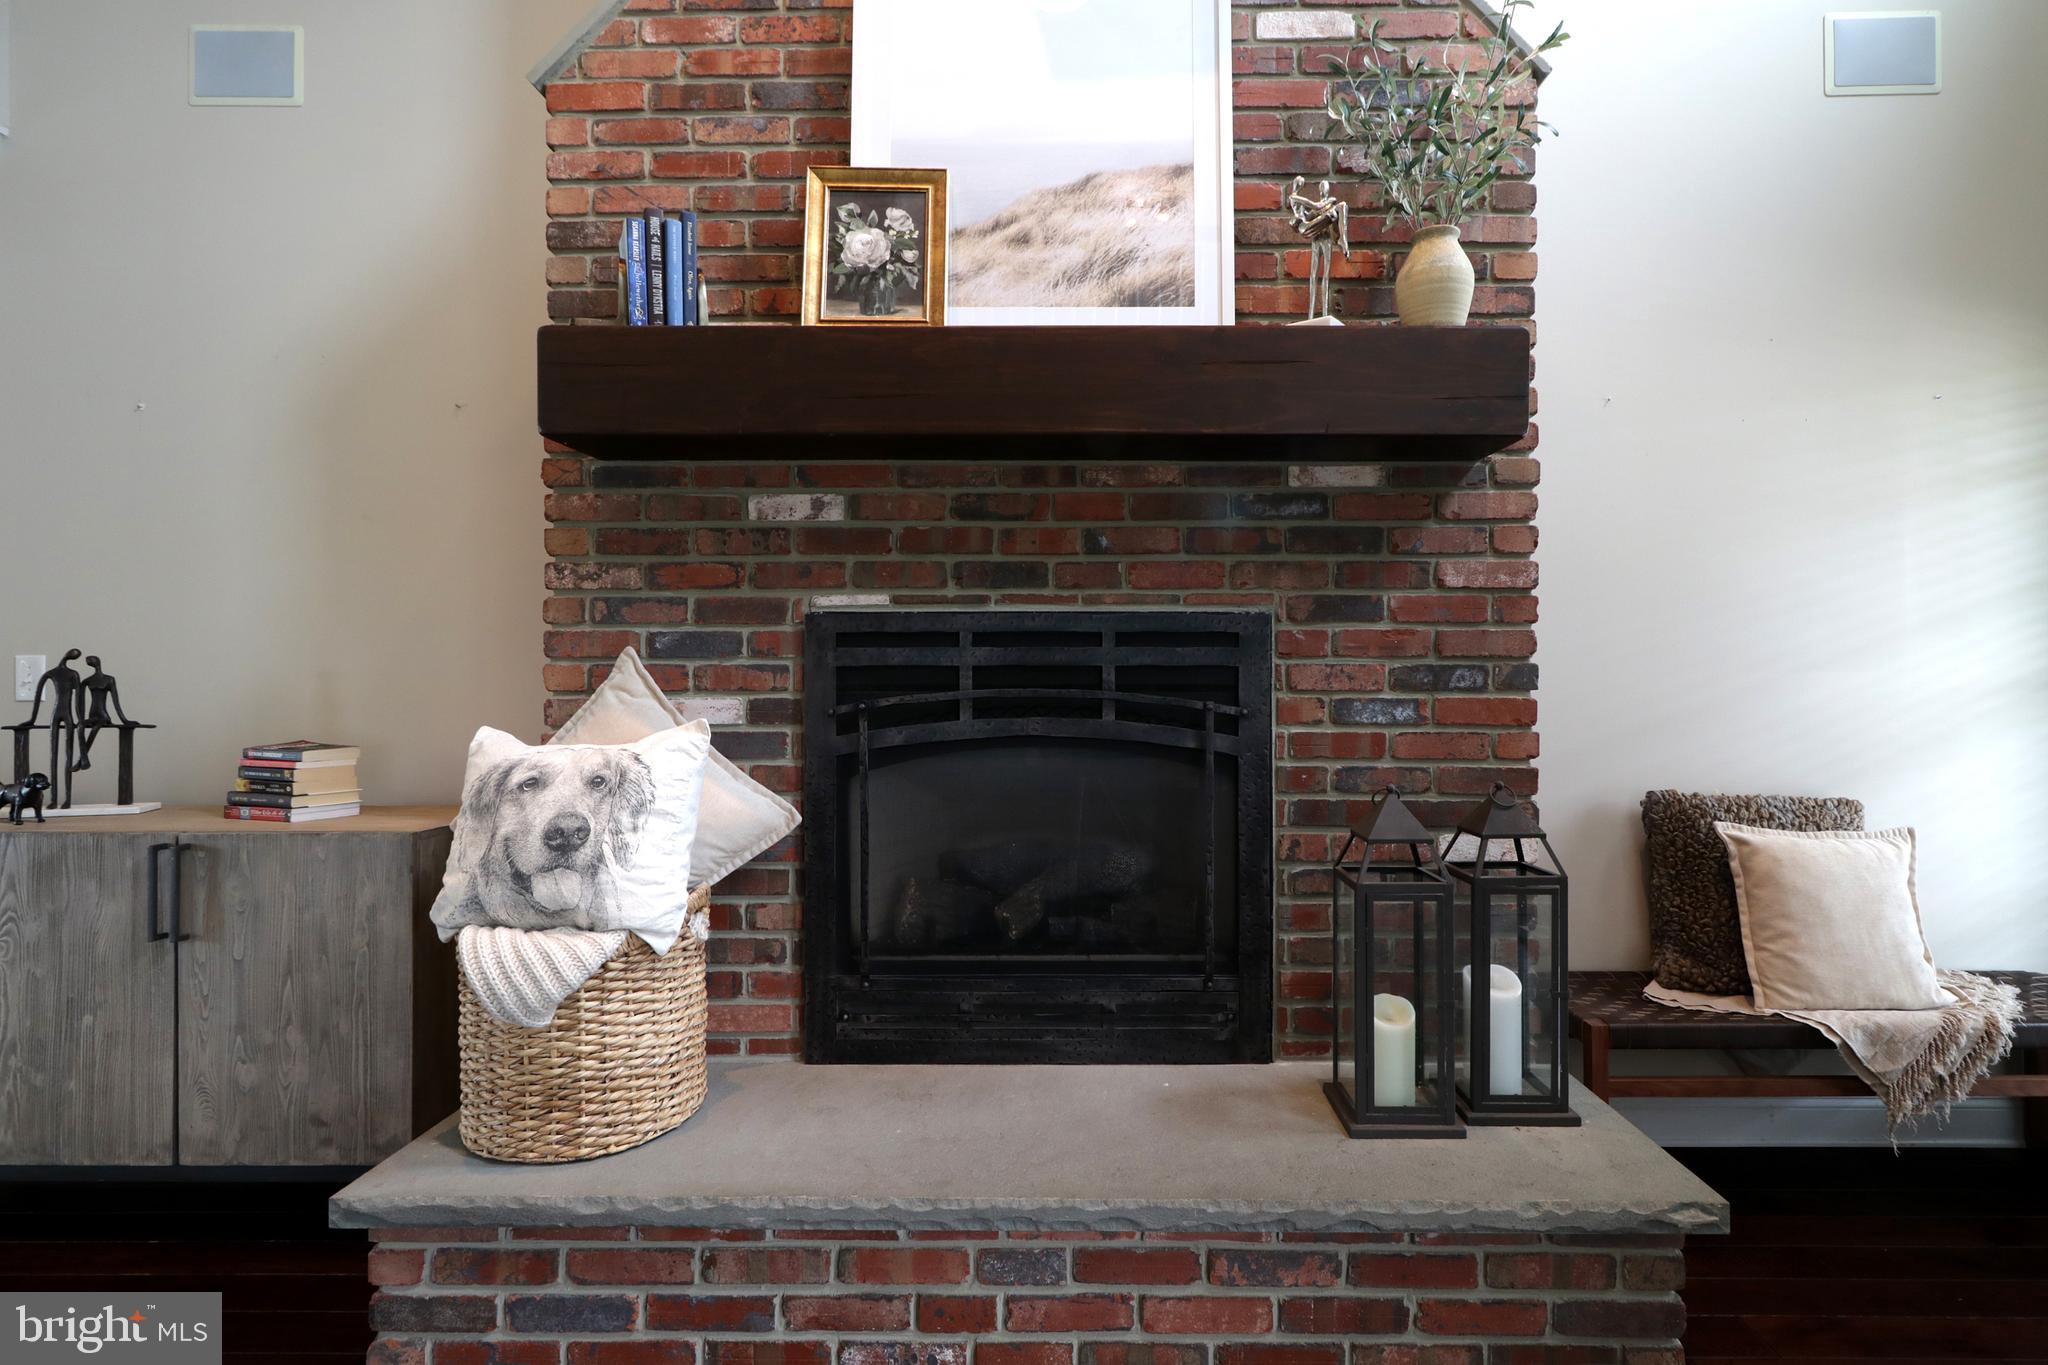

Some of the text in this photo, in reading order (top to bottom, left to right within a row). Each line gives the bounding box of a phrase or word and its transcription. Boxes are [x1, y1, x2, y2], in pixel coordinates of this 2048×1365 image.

[650, 216, 660, 236] HOUSE
[651, 244, 662, 261] NAILS
[652, 270, 663, 288] LENNY
[653, 289, 664, 315] DYKSTRA
